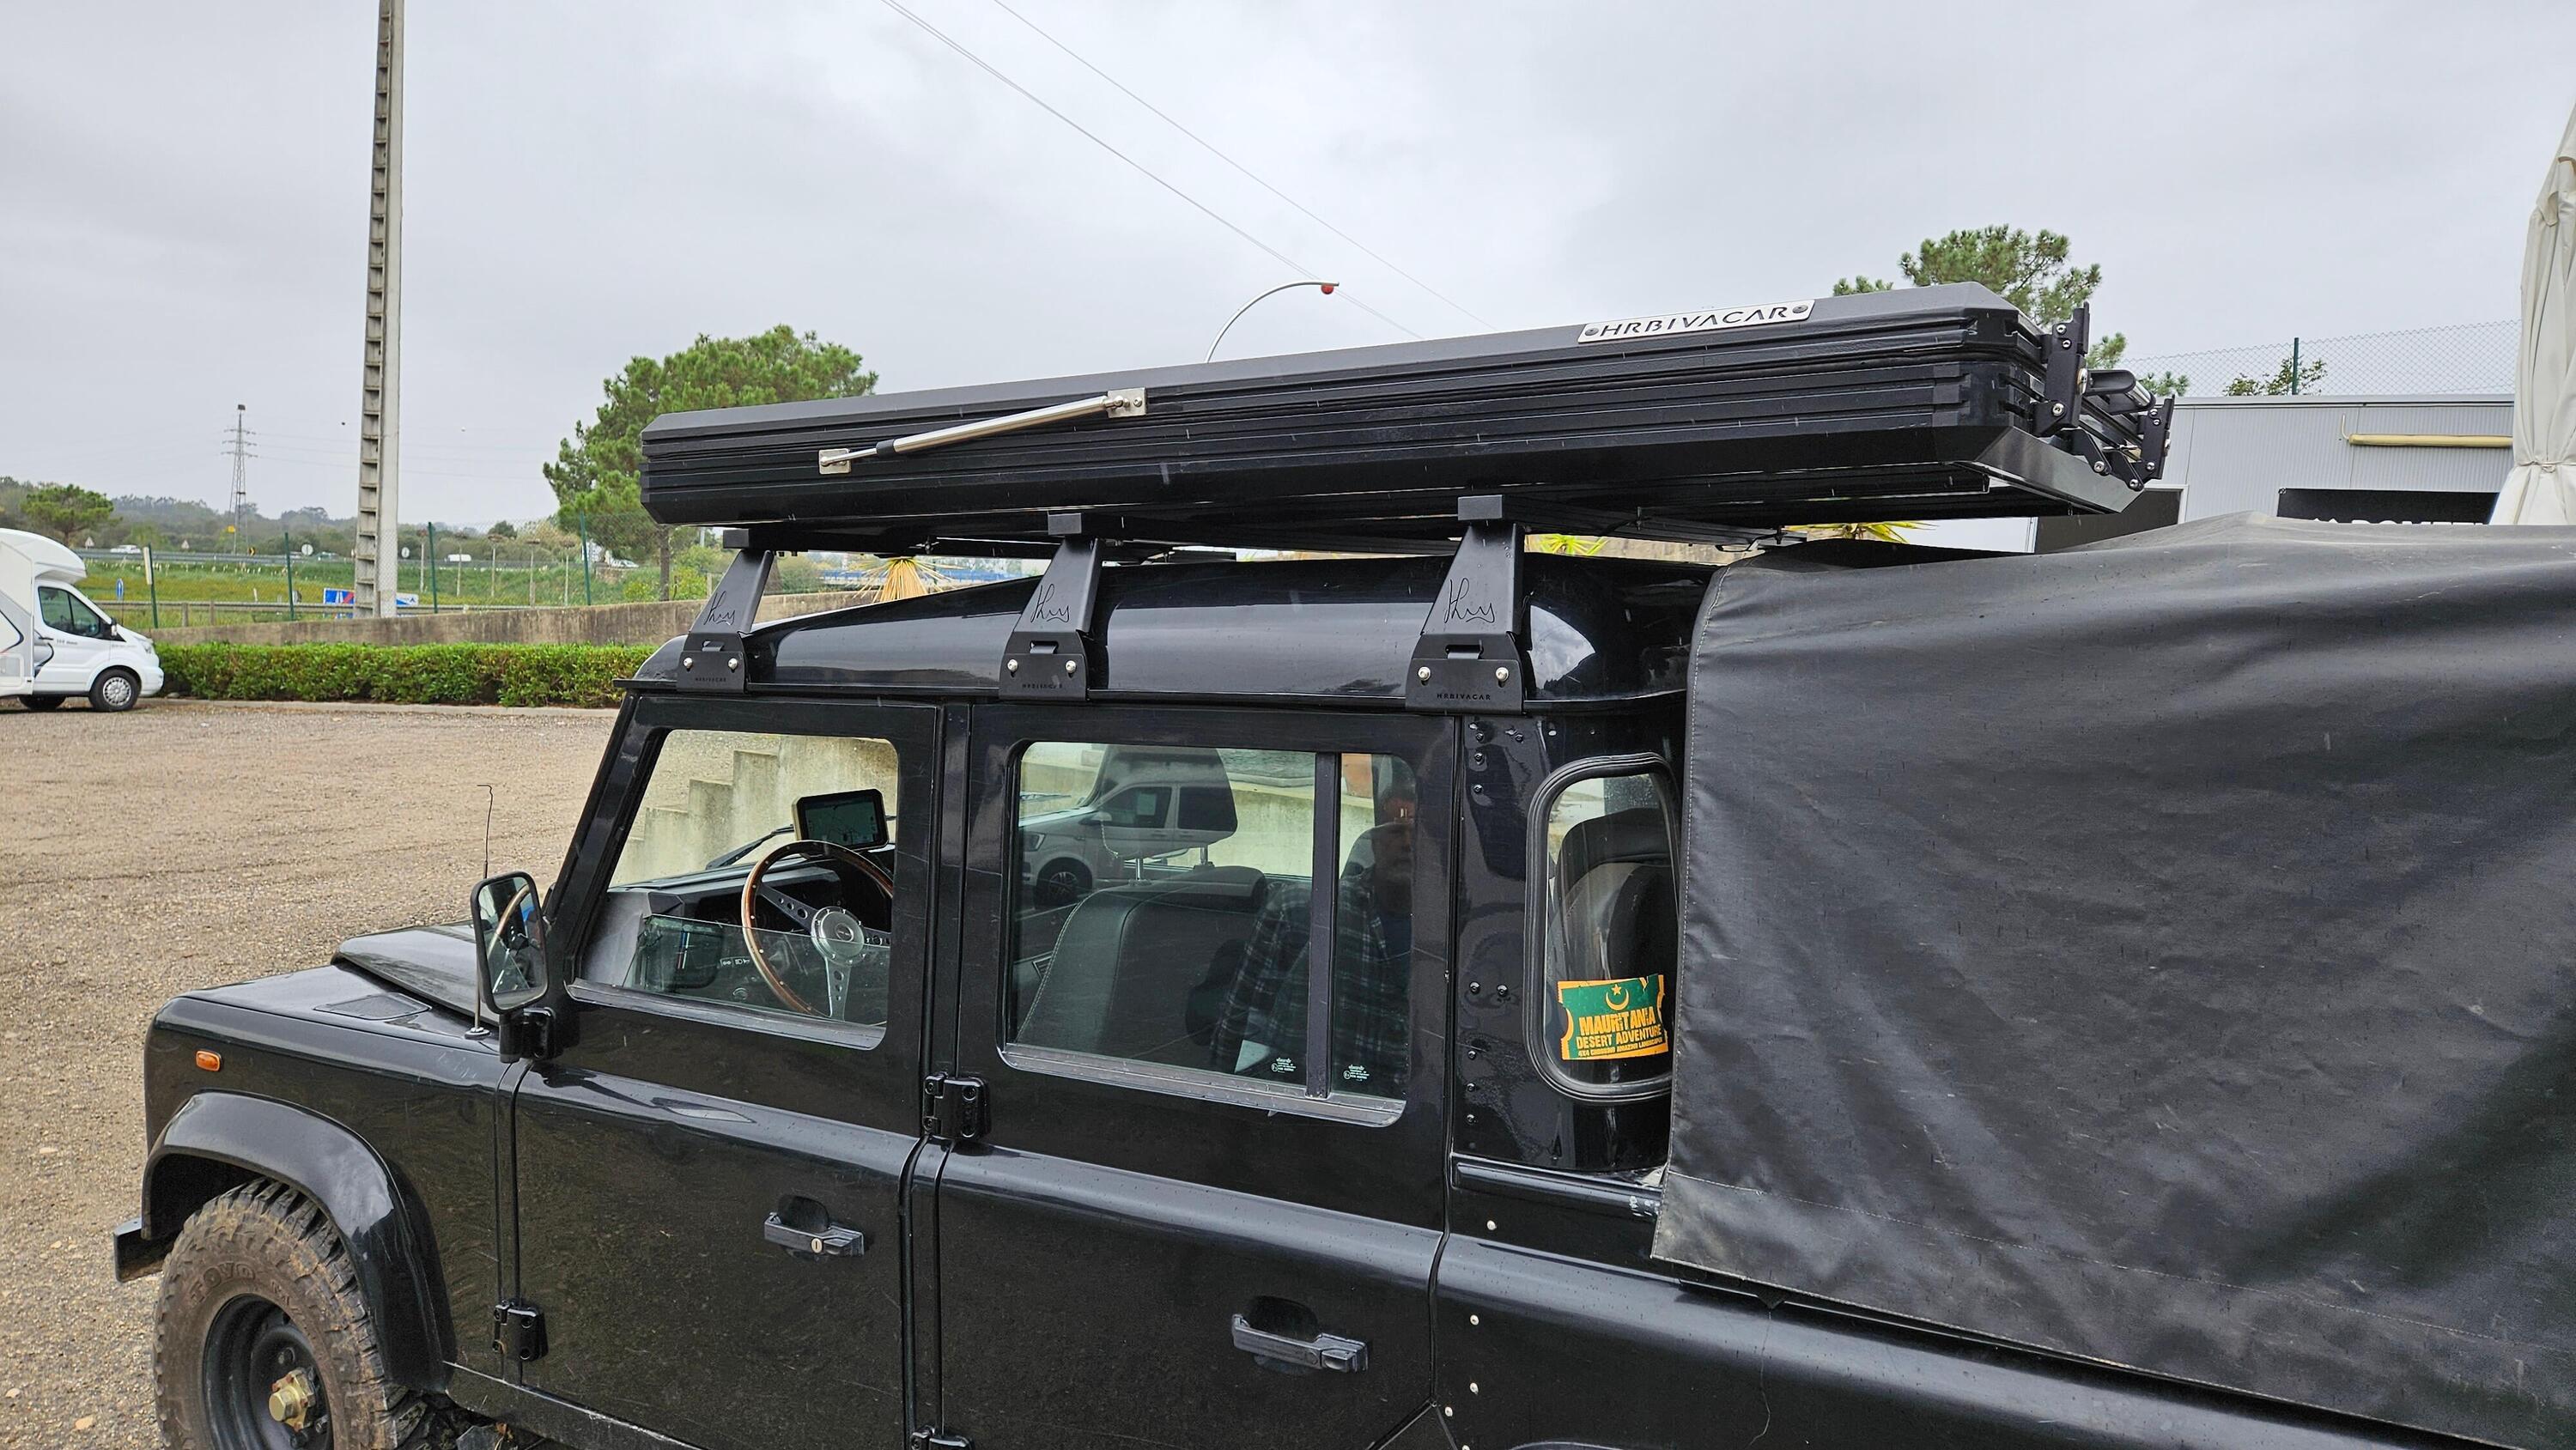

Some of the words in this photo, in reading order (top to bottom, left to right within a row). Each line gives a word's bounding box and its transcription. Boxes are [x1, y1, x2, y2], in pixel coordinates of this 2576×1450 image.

[1600, 306, 1788, 337] HRBIVACAR
[1578, 1006, 1656, 1036] MAURITANIA
[1576, 1034, 1613, 1050] DESERT
[1615, 1024, 1662, 1045] ADVENTURE
